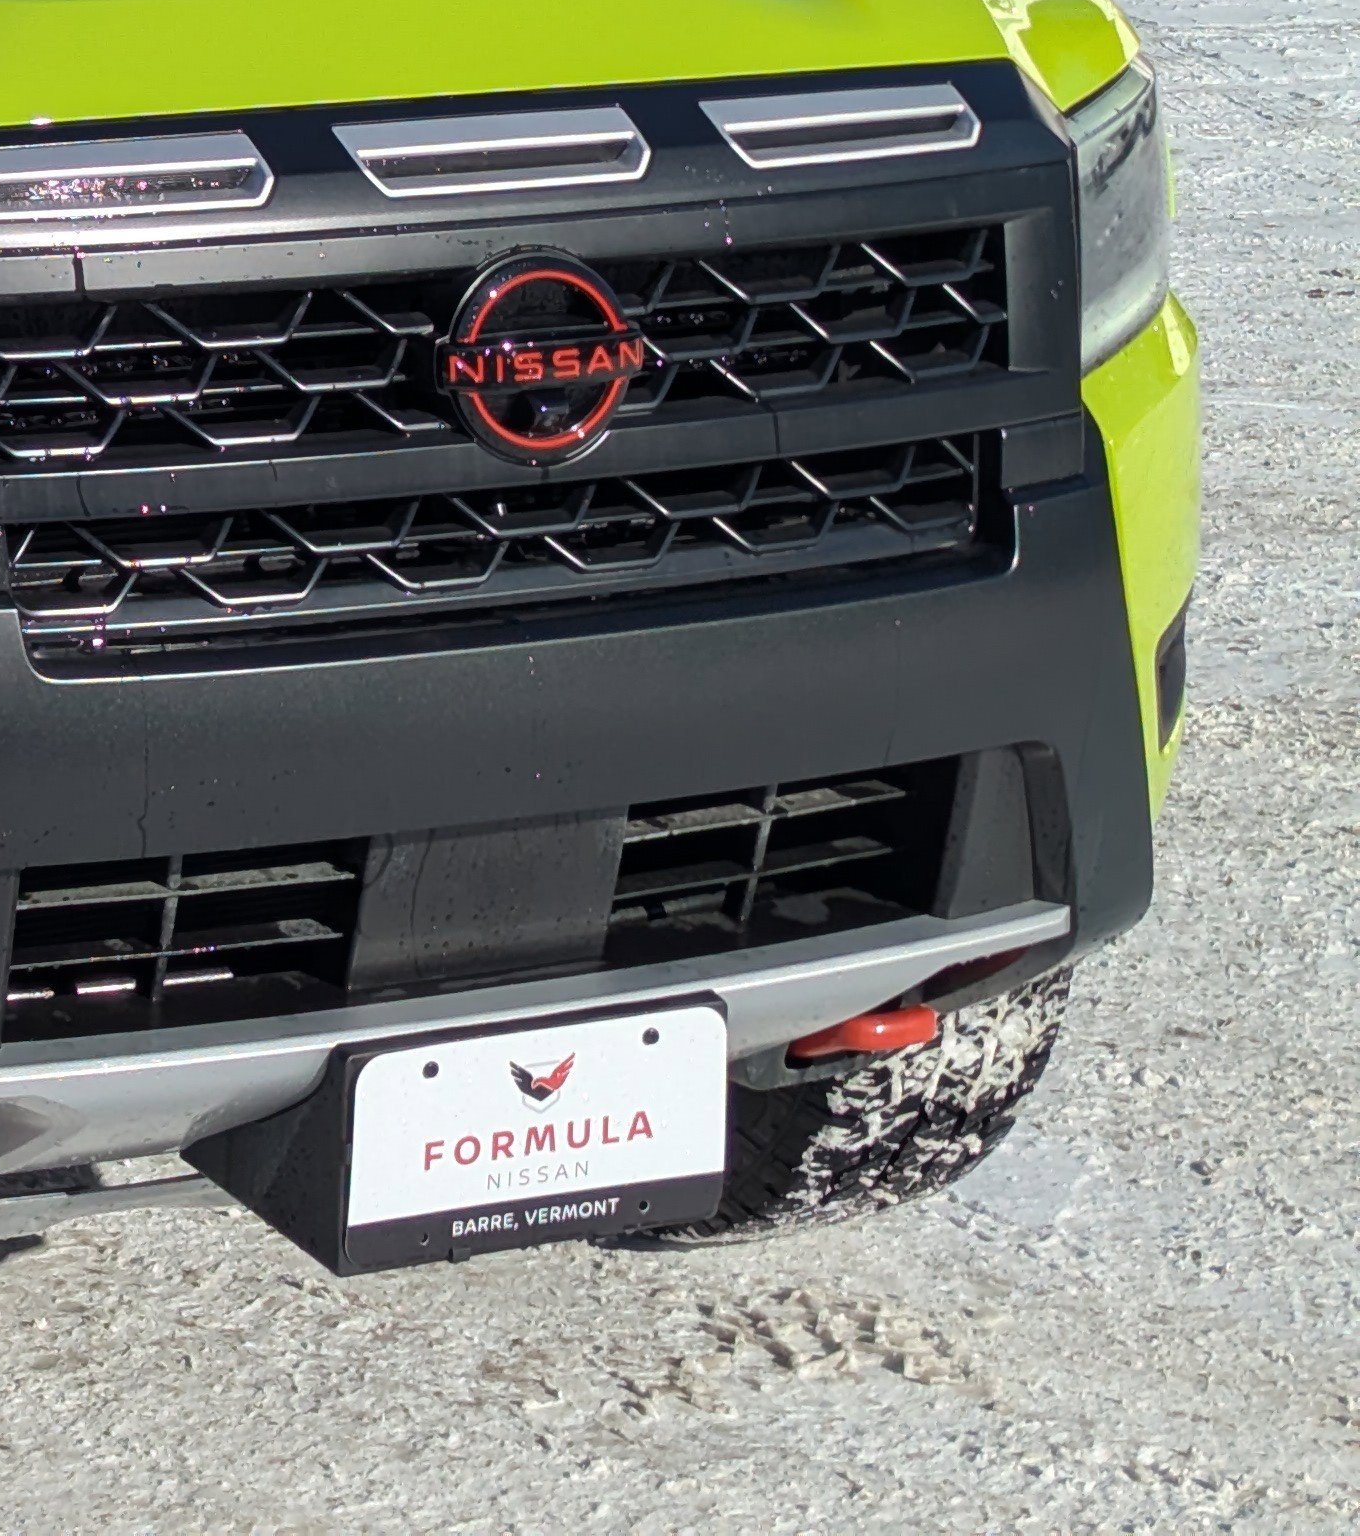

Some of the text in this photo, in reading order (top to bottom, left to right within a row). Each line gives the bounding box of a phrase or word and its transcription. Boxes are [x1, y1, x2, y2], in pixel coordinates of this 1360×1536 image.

[445, 337, 645, 384] NISSAN
[422, 1109, 655, 1172] FORMULA
[486, 1160, 591, 1191] NISSAN
[451, 1196, 620, 1238] BARRE, VERMONT
